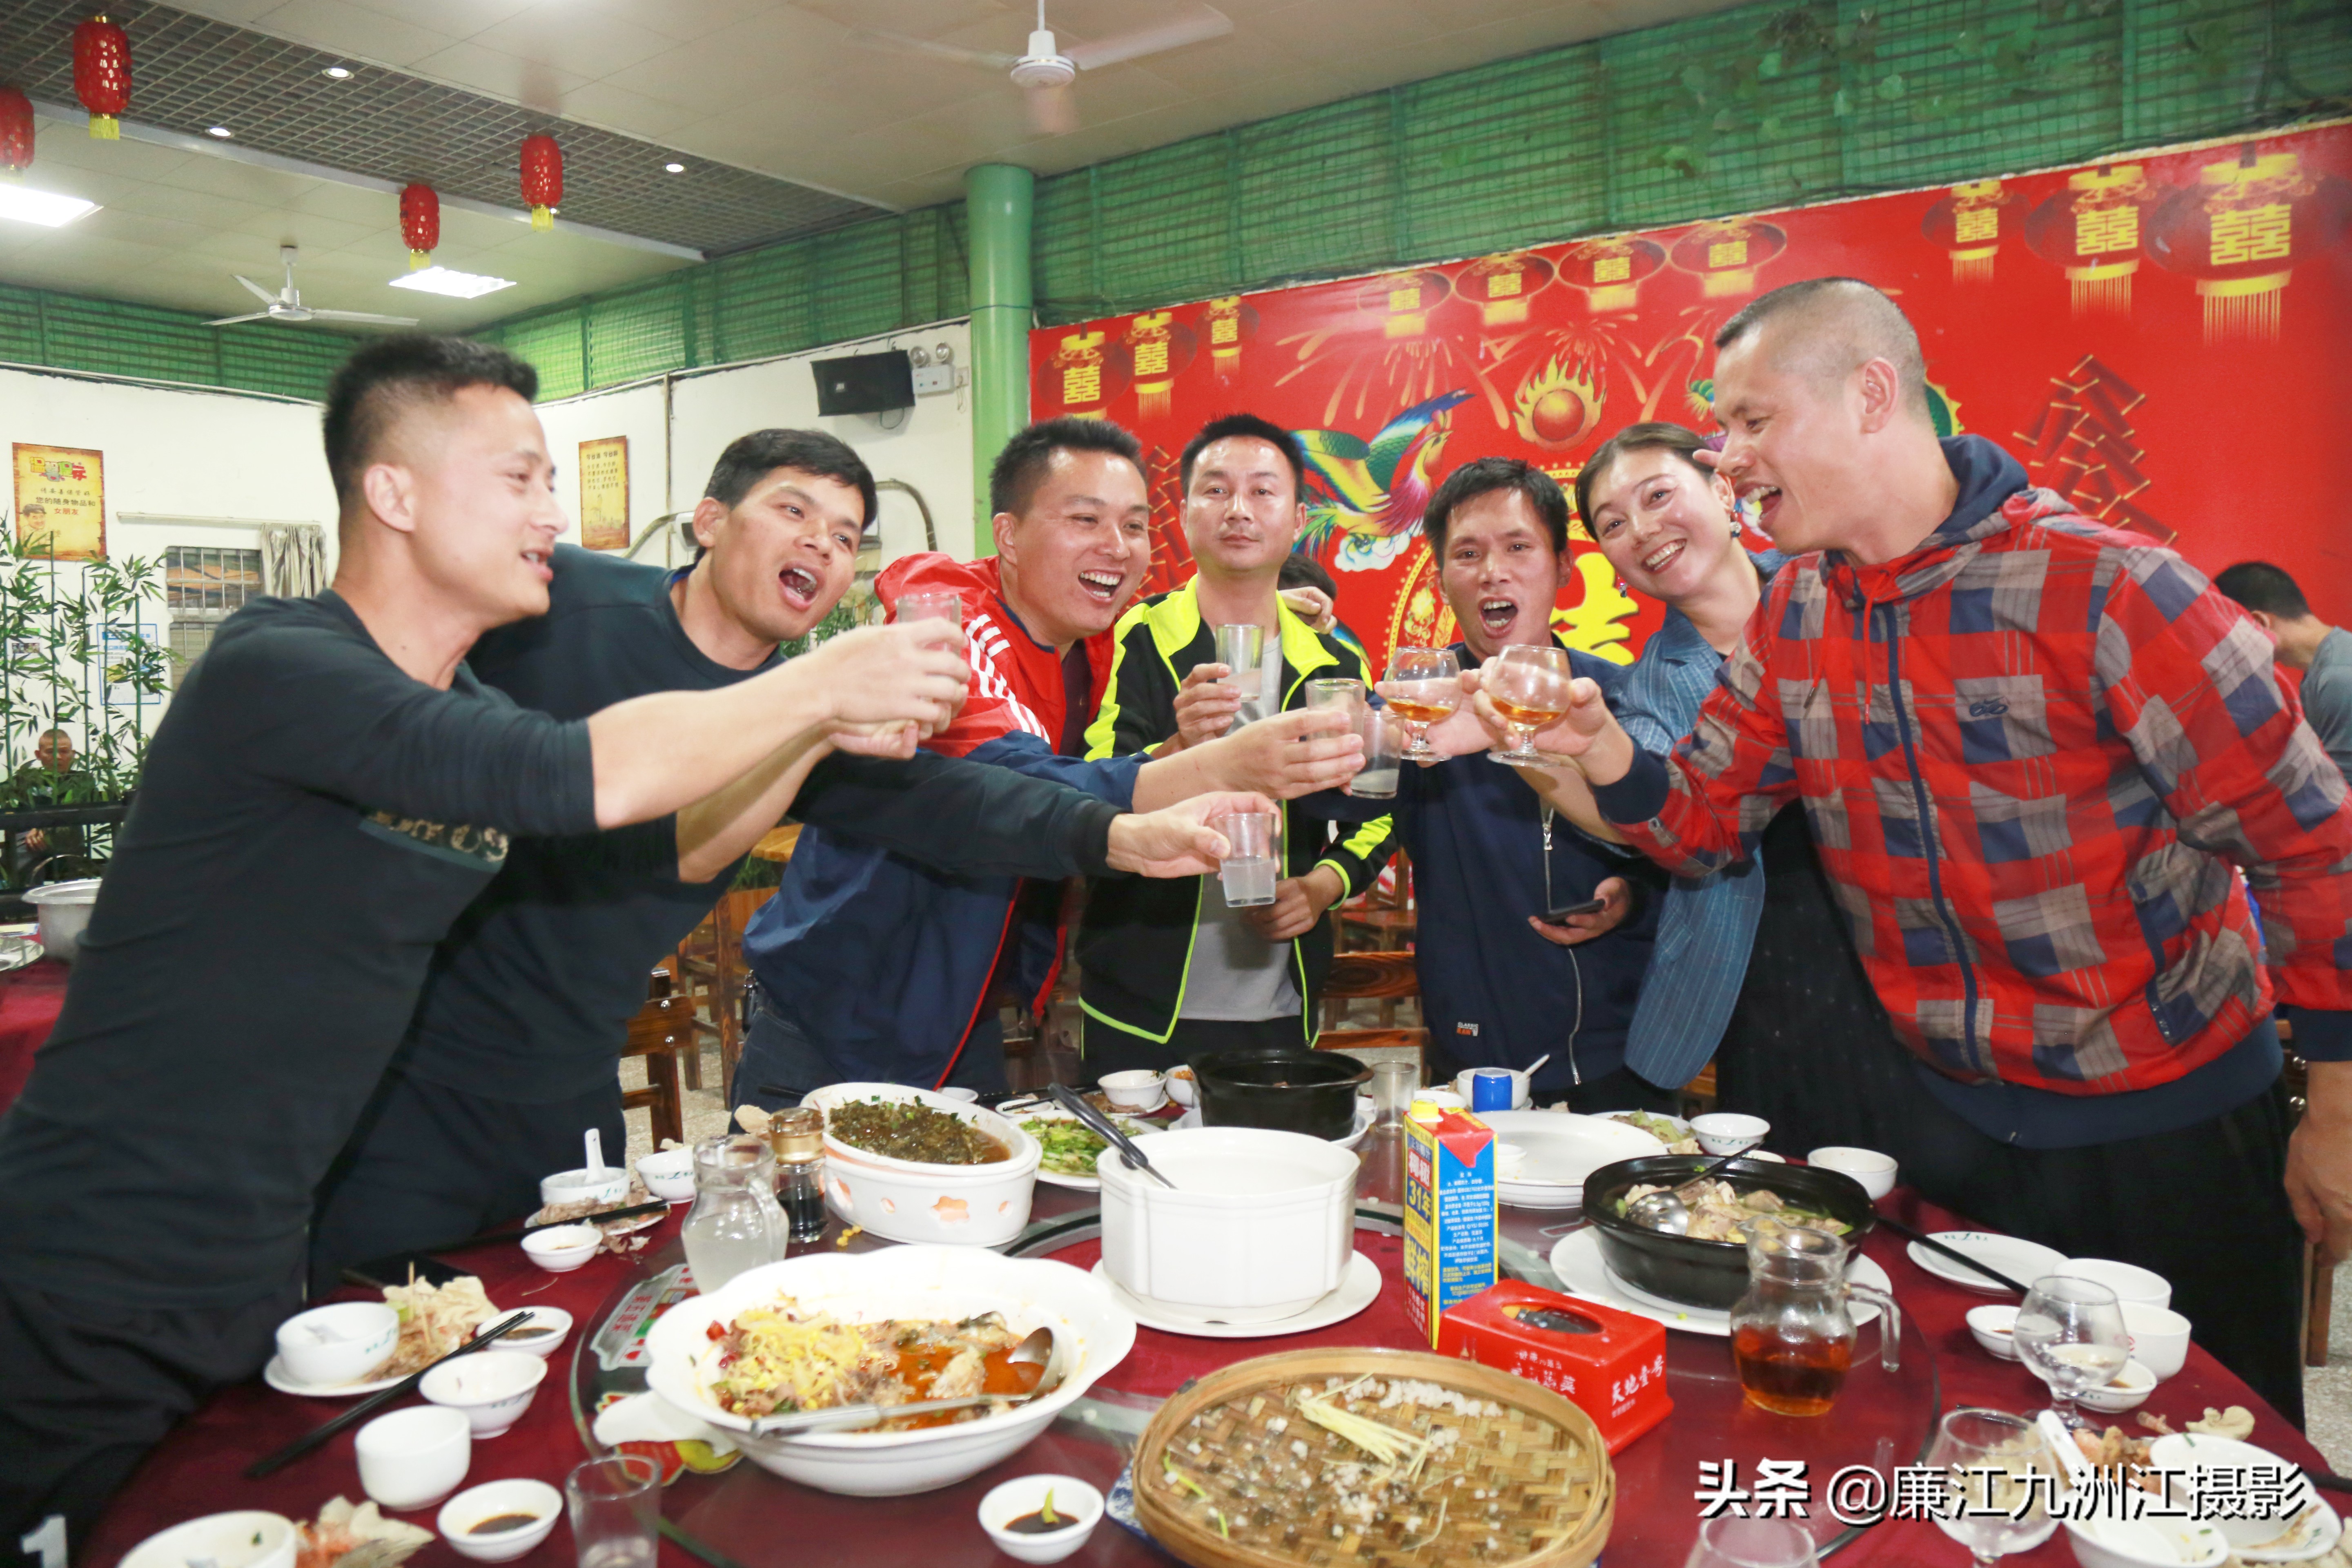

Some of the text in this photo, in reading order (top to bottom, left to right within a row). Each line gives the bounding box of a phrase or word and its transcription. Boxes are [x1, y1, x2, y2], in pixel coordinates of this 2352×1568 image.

[36, 497, 95, 506] 您的随身物品和
[1409, 1180, 1431, 1218] 31年
[1612, 1354, 1664, 1406] 天地壹号
